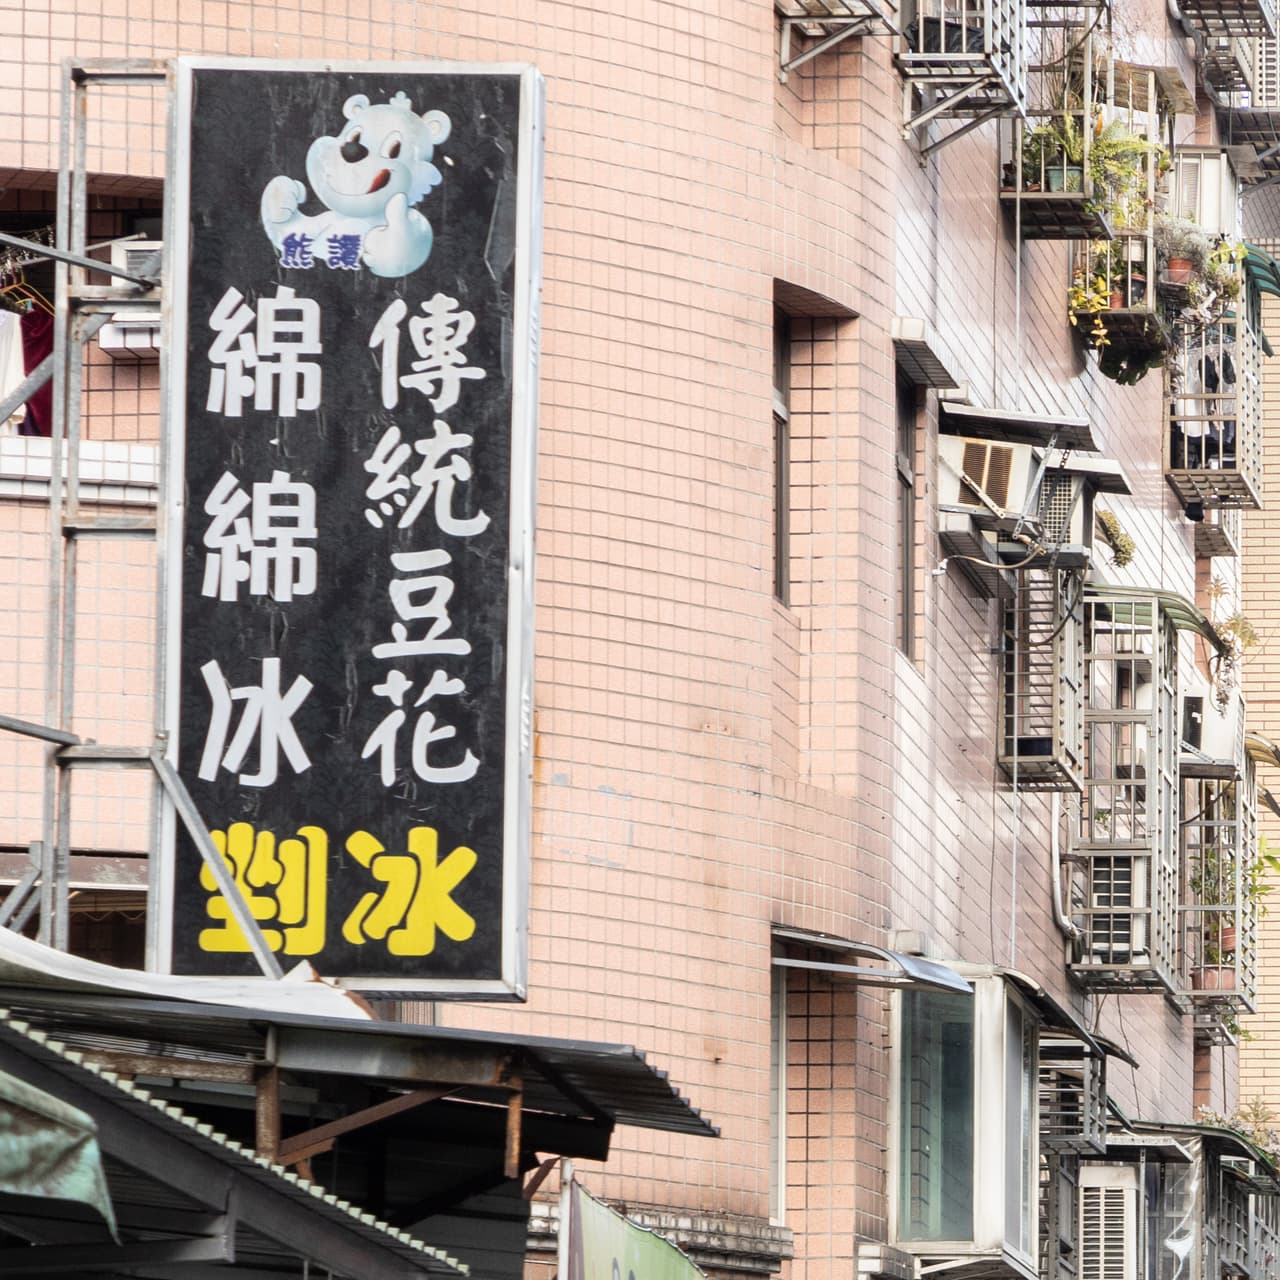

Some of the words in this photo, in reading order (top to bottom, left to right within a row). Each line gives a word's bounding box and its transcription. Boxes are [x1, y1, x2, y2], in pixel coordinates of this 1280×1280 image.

[199, 285, 323, 787] 綿綿冰
[362, 292, 491, 788] 傳統豆花
